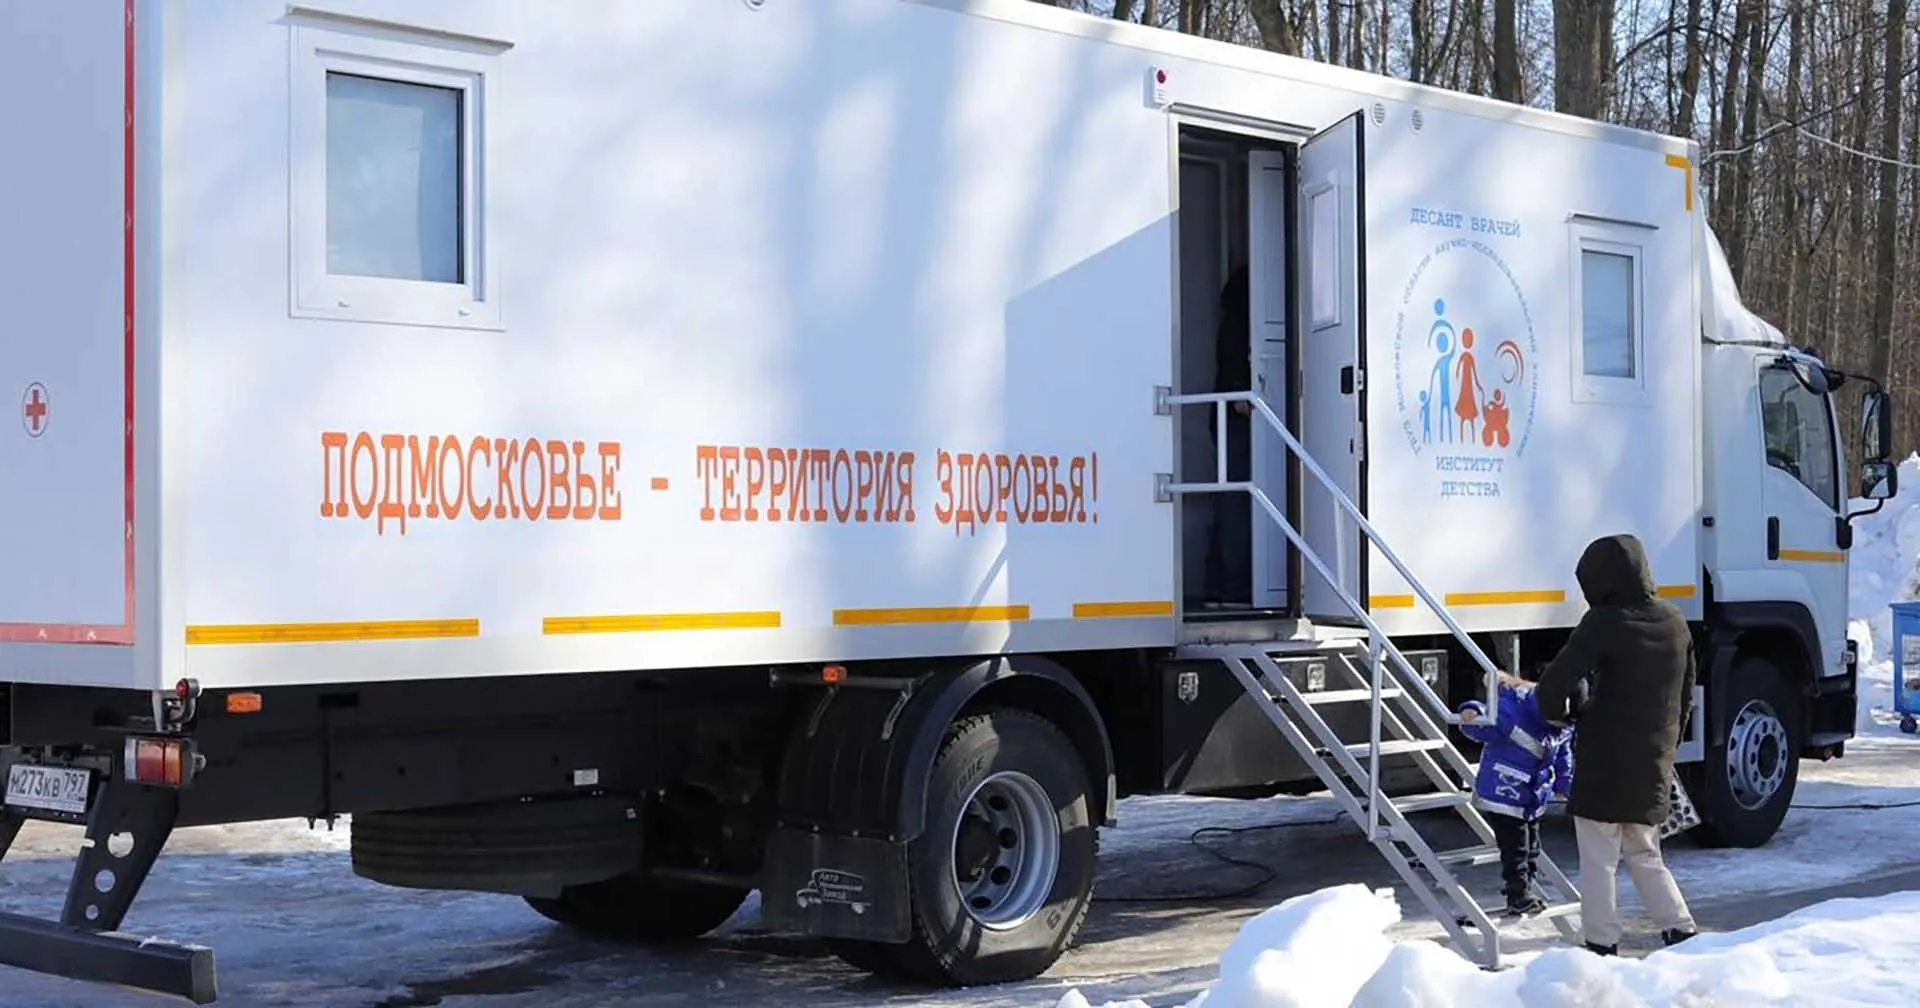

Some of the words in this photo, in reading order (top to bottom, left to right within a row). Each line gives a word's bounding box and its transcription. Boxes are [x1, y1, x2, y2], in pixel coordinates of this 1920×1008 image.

[1410, 208, 1463, 229] ДЕСАНТ
[1471, 217, 1521, 238] ВРАЧЕЙ
[1435, 456, 1505, 472] ИНСТИТУТ
[320, 431, 622, 535] ПОДМОСКОВЬЕ
[651, 477, 669, 490] -
[696, 445, 915, 522] ТЕРРИТОРИЯ
[935, 448, 1099, 537] ЗДОРОВЬЯ!
[1440, 481, 1501, 498] ДЕТСТВА
